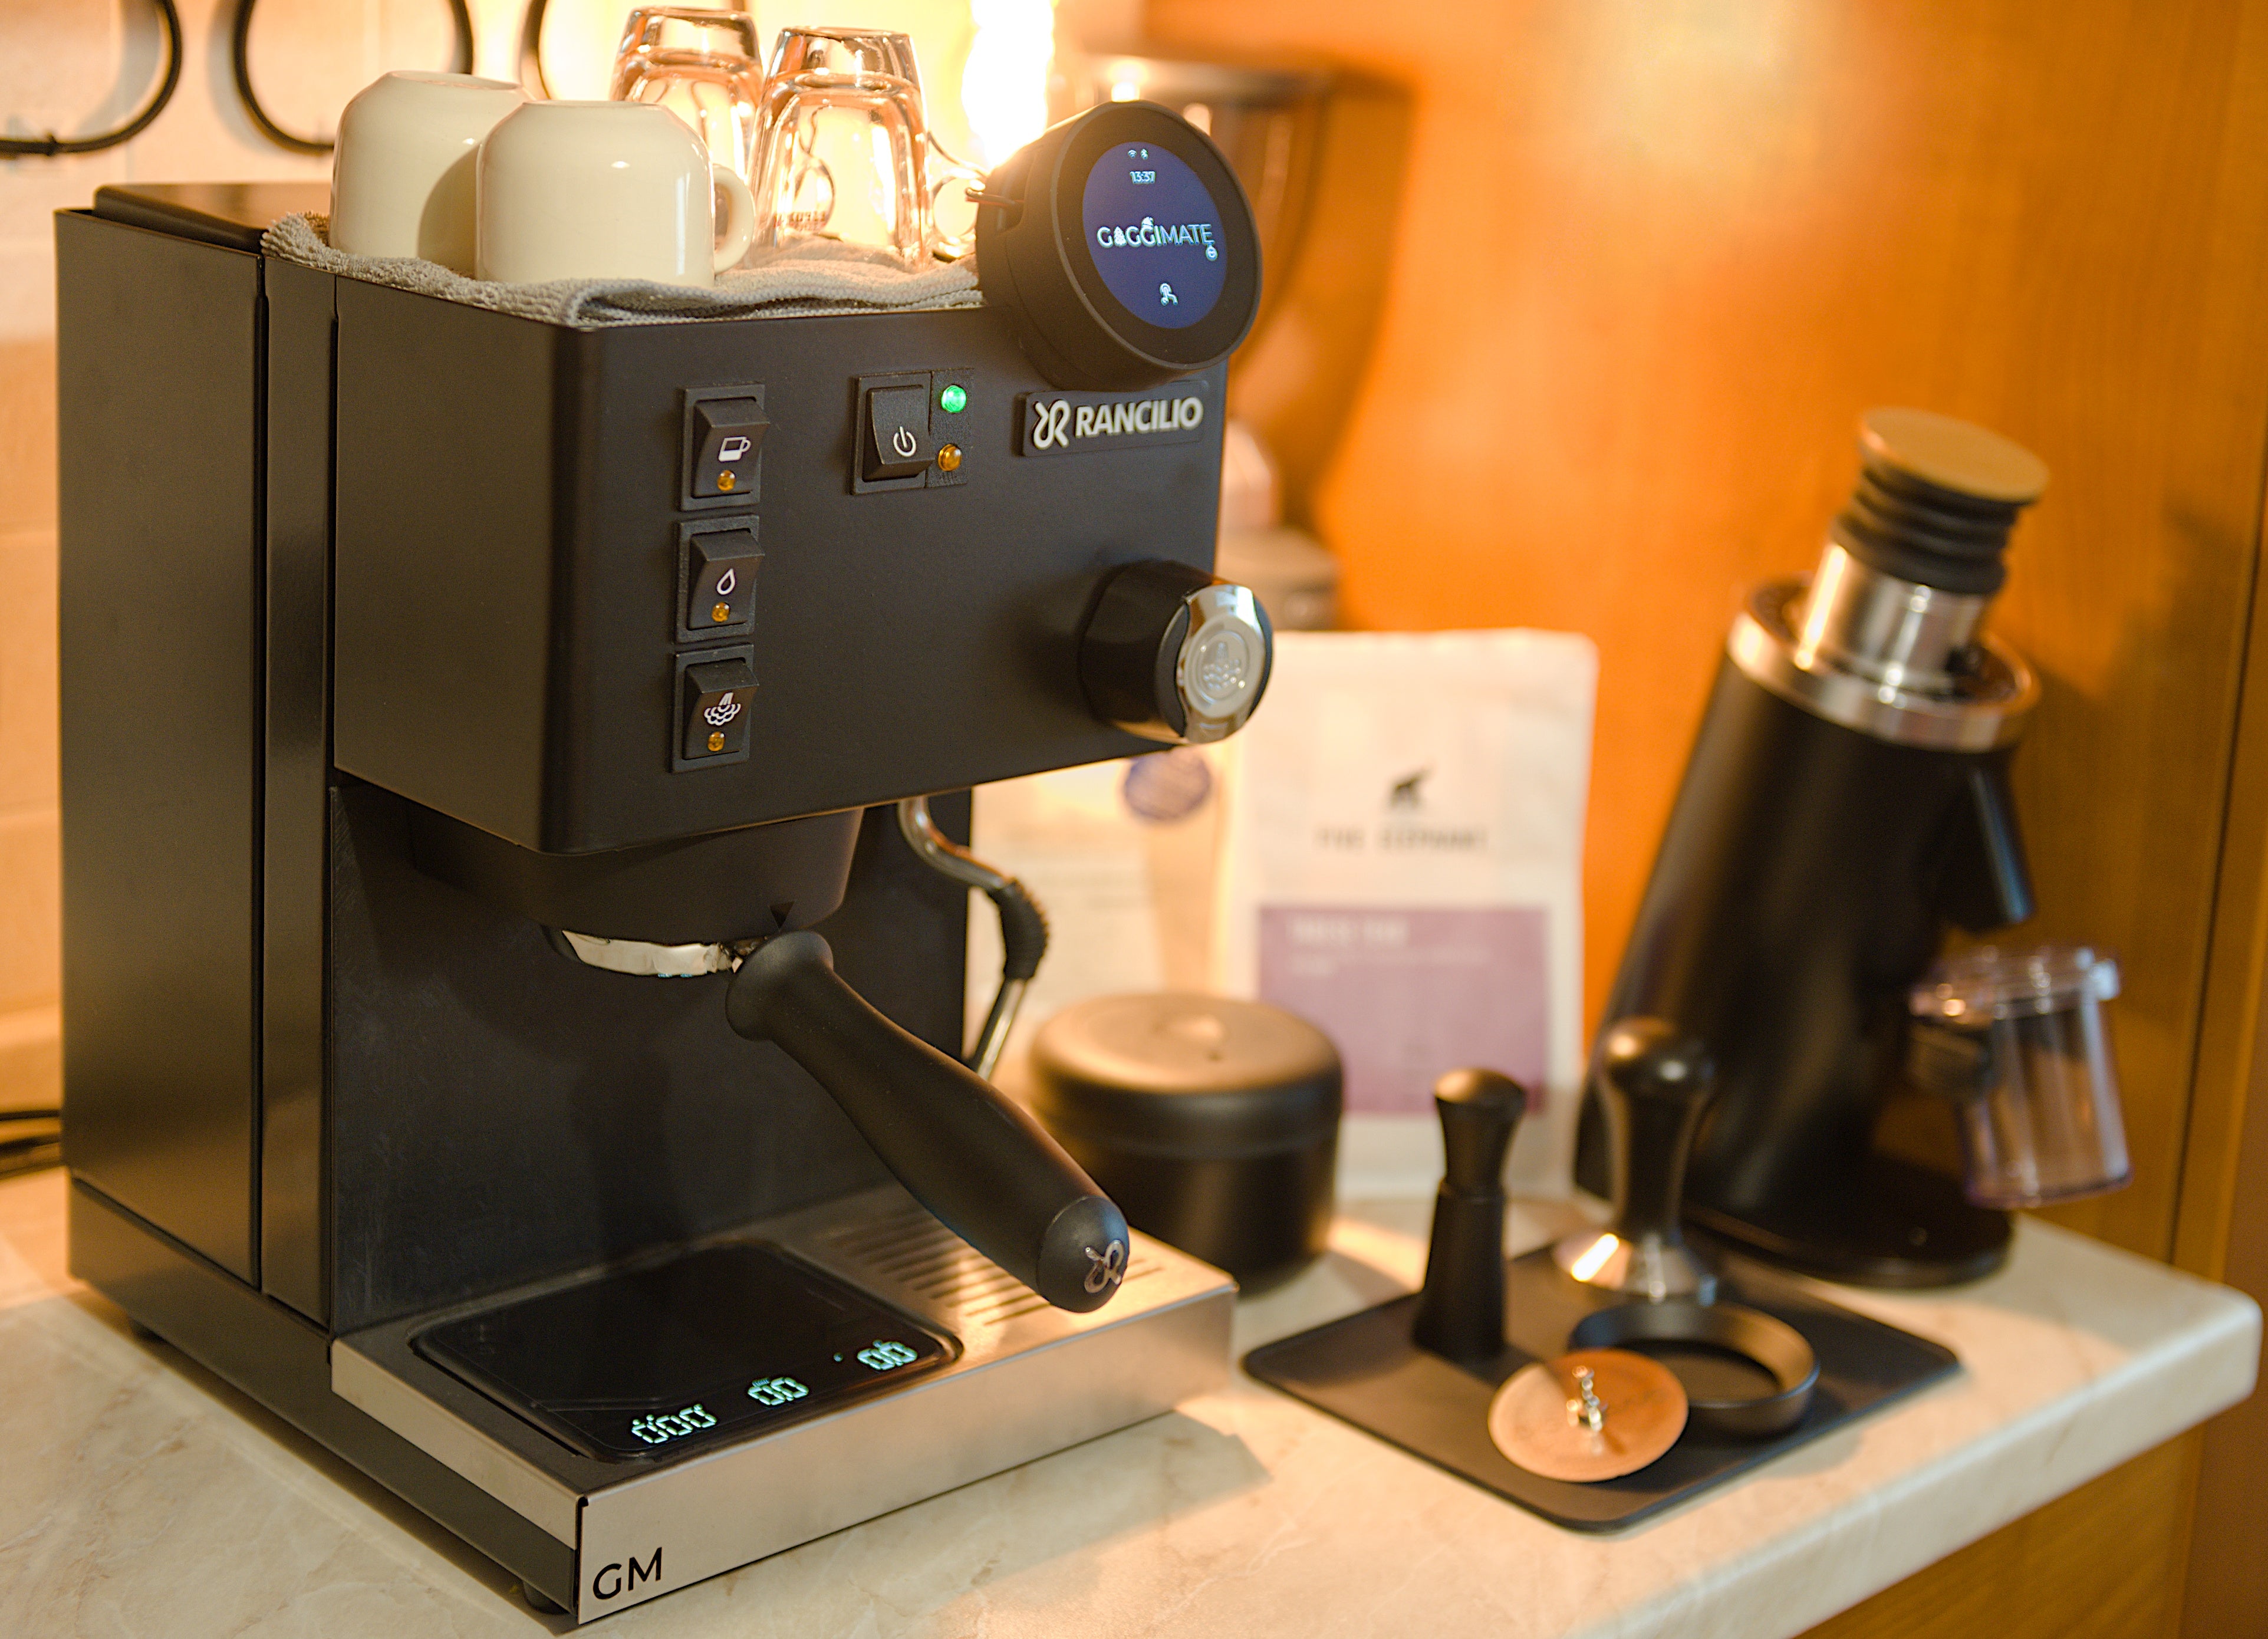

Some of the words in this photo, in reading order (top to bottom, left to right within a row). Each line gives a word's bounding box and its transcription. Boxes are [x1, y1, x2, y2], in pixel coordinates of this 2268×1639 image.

[1129, 170, 1156, 184] 13:37
[1074, 397, 1204, 438] RANCILIO
[592, 1546, 662, 1600] GM
